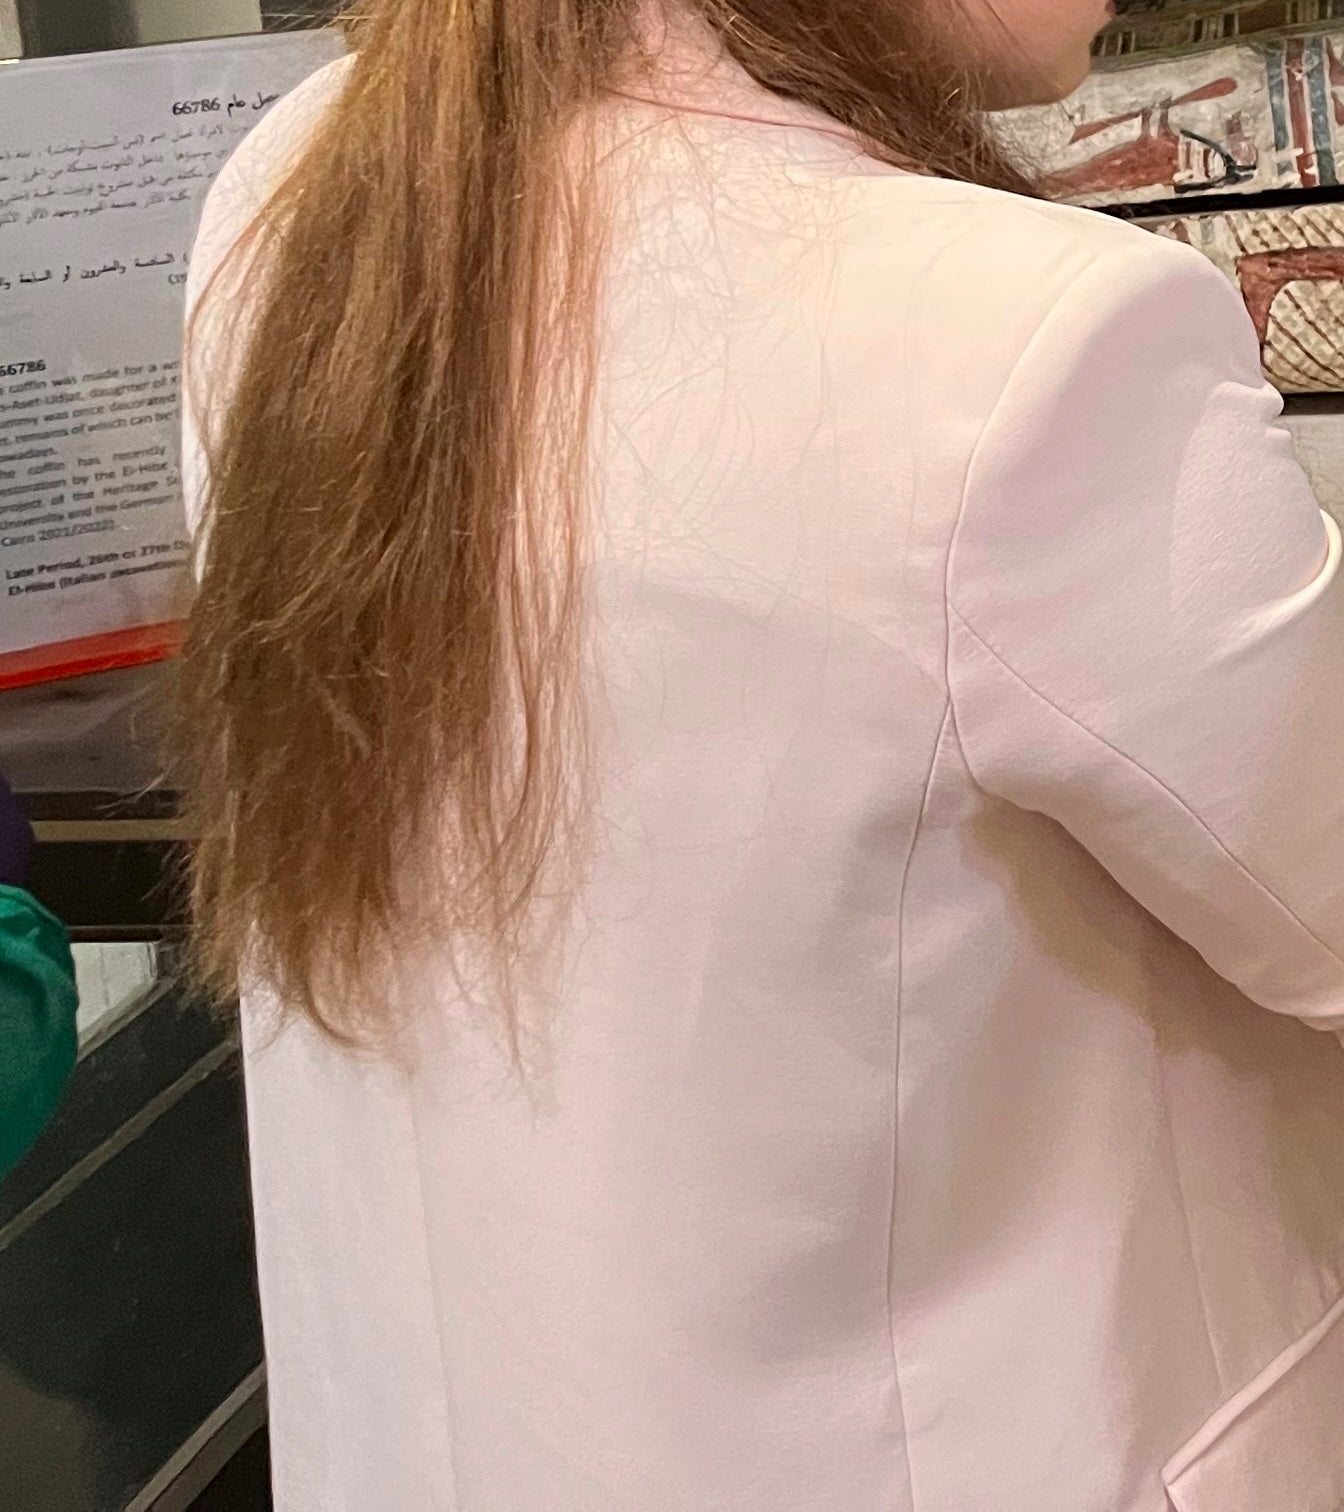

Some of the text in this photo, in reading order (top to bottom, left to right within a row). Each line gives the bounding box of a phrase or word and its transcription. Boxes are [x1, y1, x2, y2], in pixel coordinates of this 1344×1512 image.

[172, 97, 221, 116] 66786
[52, 376, 77, 388] was
[124, 365, 144, 375] for
